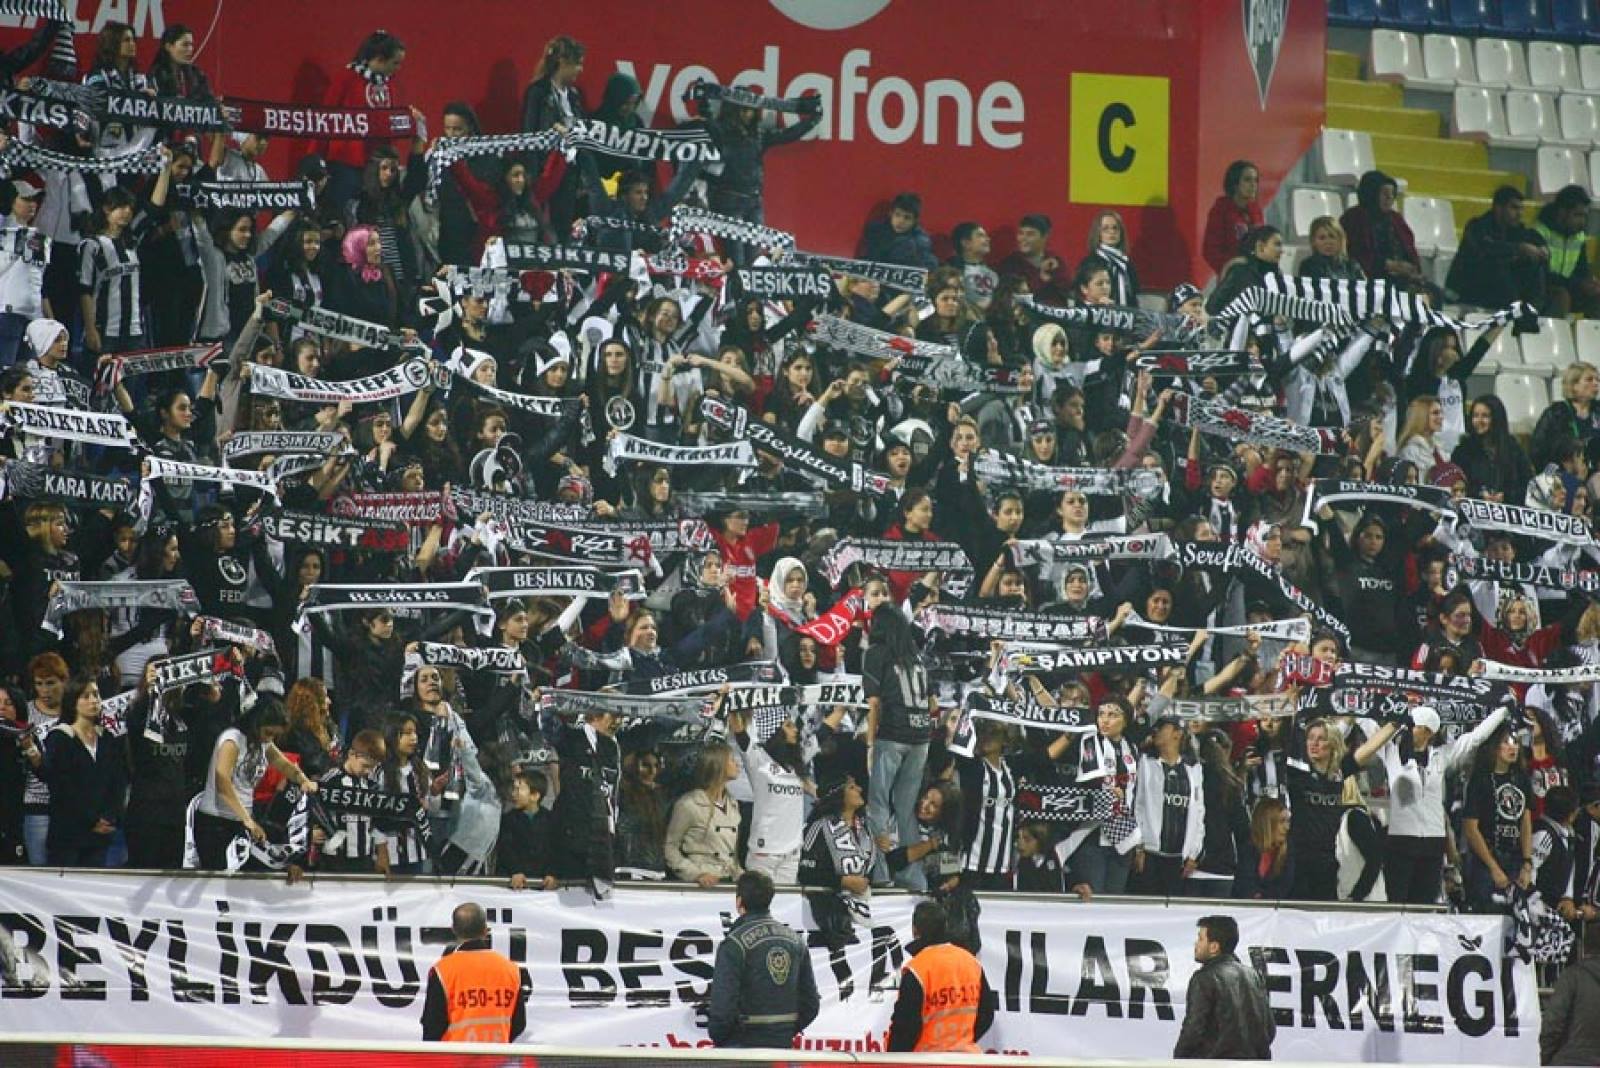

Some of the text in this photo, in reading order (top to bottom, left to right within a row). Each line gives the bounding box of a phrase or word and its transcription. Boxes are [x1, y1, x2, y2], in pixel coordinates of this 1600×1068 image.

[107, 95, 223, 125] KARA KARTAL
[617, 45, 1025, 150] vodafone
[264, 107, 369, 135] BEŞİKTAŞ
[1097, 102, 1137, 173] C
[506, 243, 629, 270] BEŞİKTAŞ
[738, 271, 831, 298] BEŞİKTAŞ
[45, 474, 87, 499] KARA
[513, 570, 595, 591] BEŞİKTAŞ
